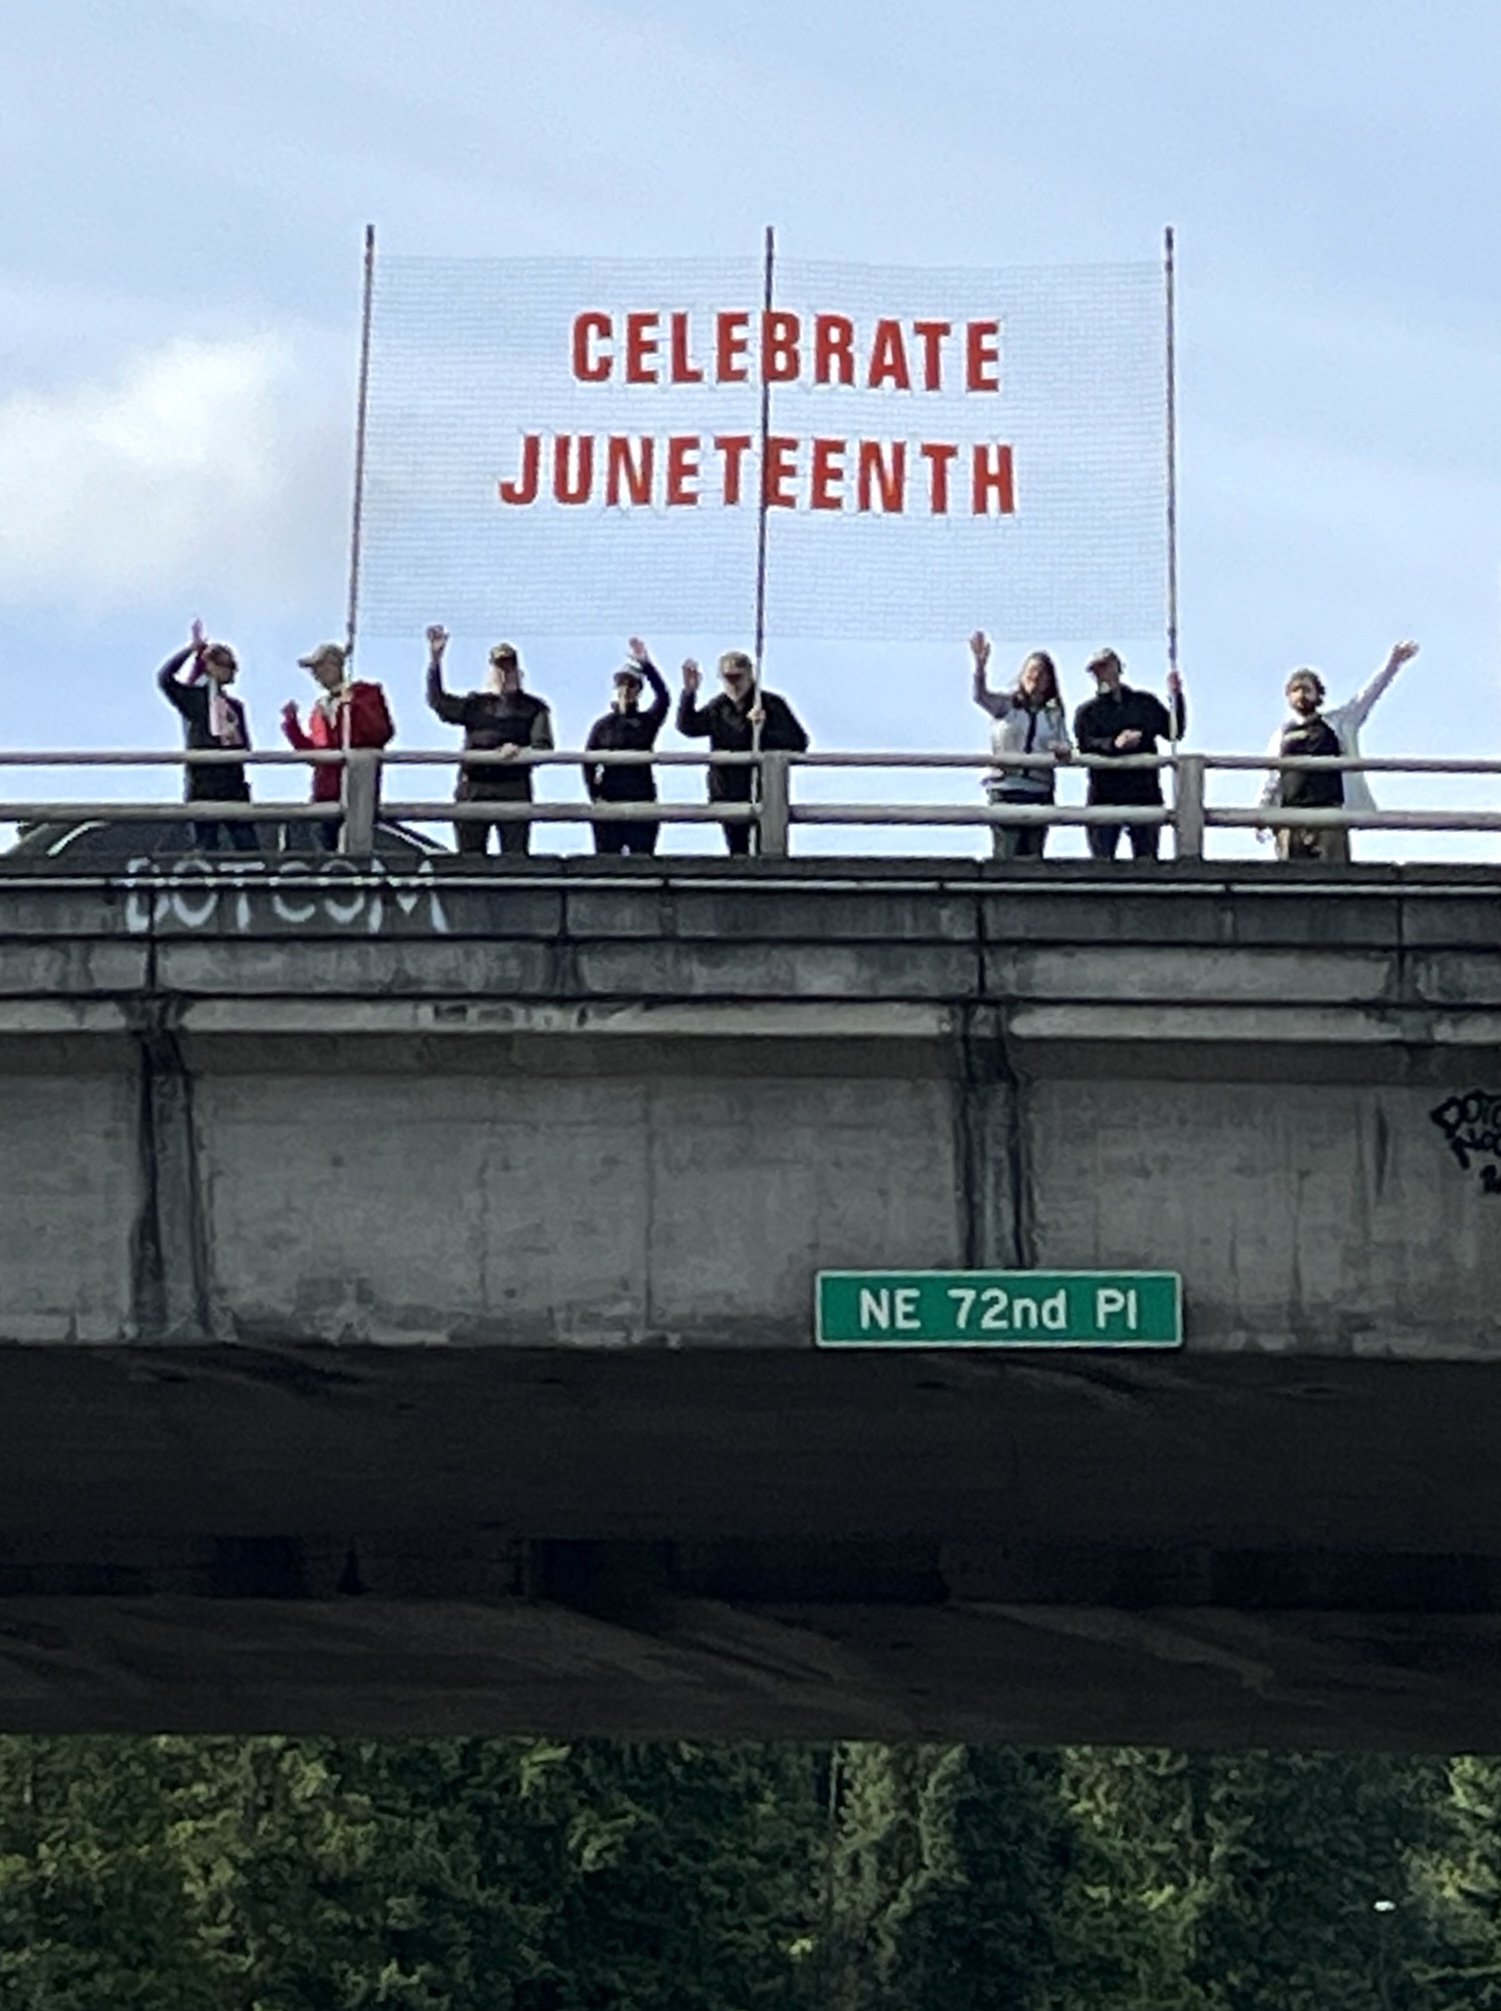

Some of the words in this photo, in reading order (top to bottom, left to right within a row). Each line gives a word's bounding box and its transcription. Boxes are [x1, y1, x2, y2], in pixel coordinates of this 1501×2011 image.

[572, 311, 999, 392] CELEBRATE
[500, 435, 1015, 514] JUNETEENTH
[125, 856, 449, 933] DOTCOM
[861, 1289, 920, 1328] NE
[949, 1289, 1065, 1329] 72nd
[1098, 1289, 1136, 1328] Pl
